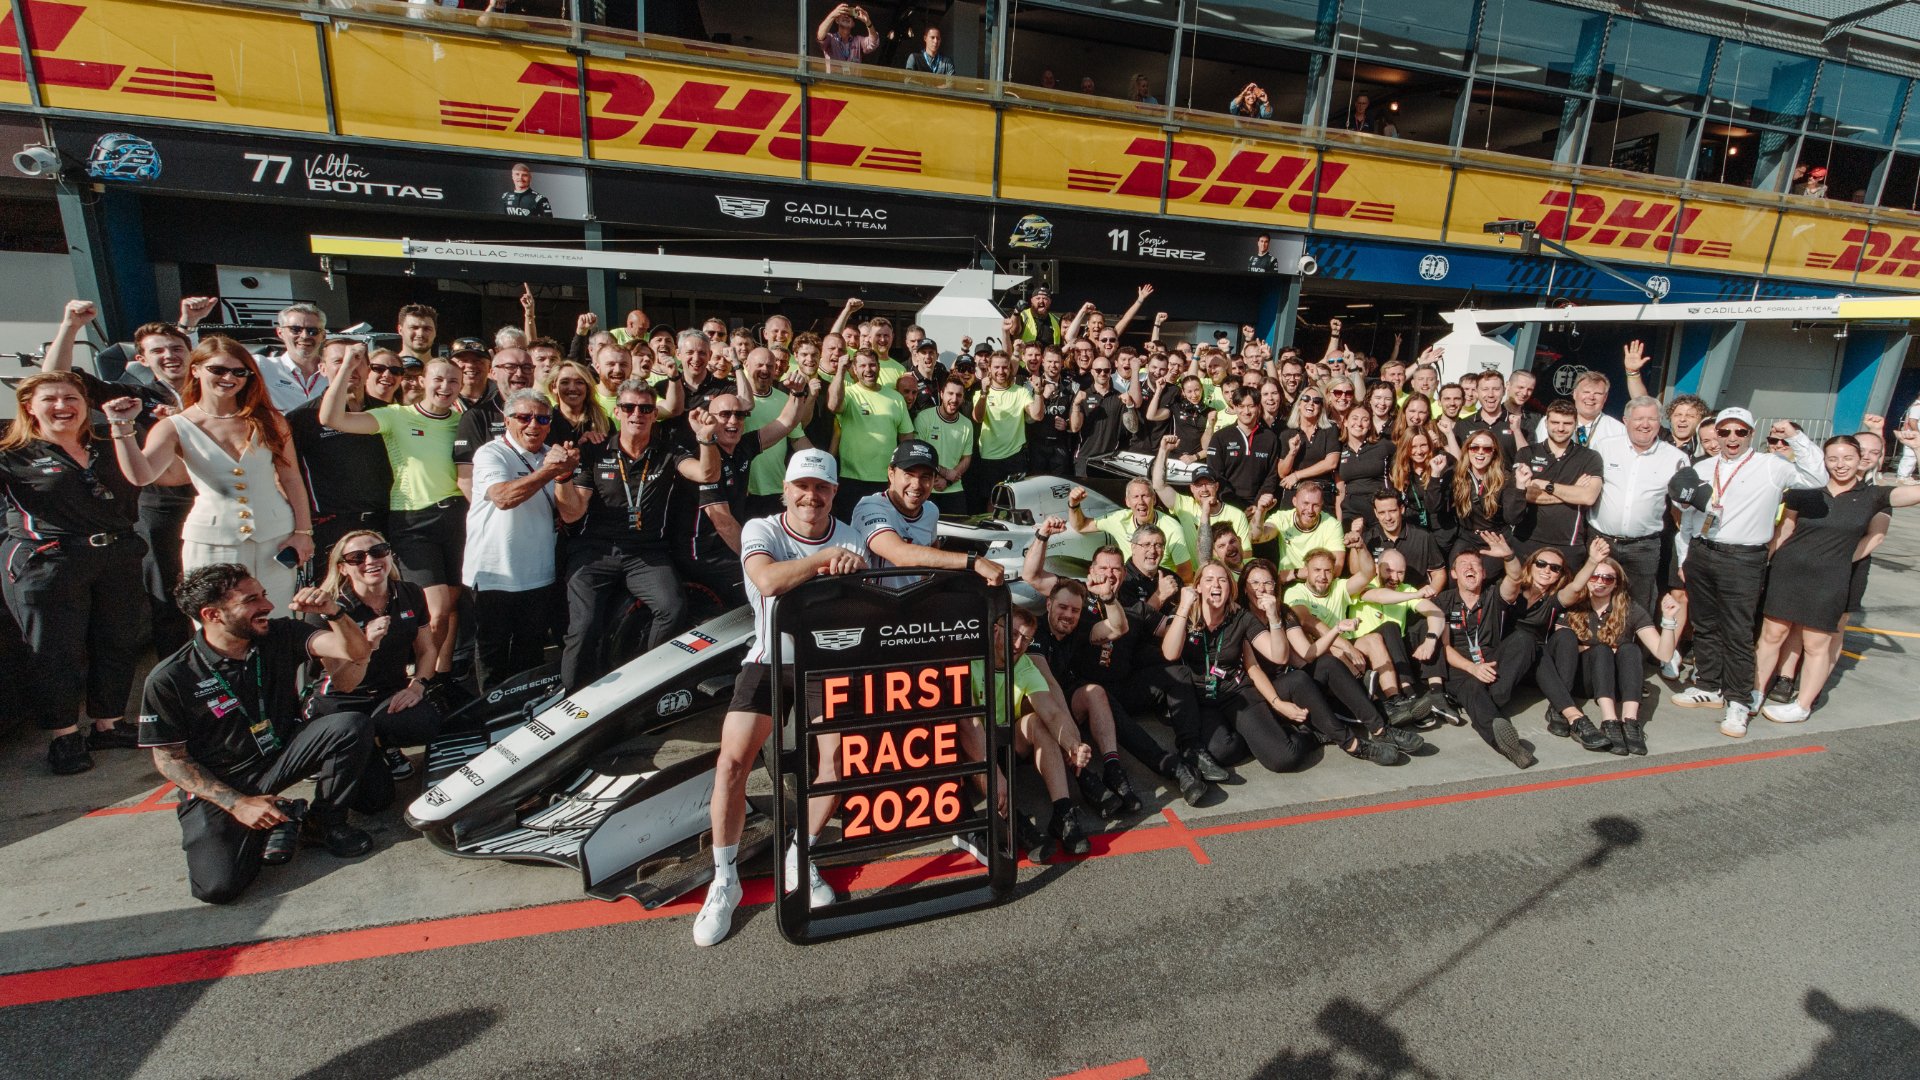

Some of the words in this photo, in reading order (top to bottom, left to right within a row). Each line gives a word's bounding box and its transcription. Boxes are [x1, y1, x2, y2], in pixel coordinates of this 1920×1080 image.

[515, 61, 866, 167] DHL
[244, 153, 293, 184] 77
[304, 153, 370, 181] Valtteri
[1116, 137, 1356, 217] DHL
[308, 178, 444, 200] BOTTAS
[784, 201, 888, 220] CADILLAC
[785, 216, 842, 227] FORMULA
[852, 221, 887, 231] TEAM
[1535, 189, 1704, 255] DHL
[1108, 228, 1129, 252] 11
[1138, 229, 1168, 250] Sergio
[434, 247, 508, 258] CADILLAC
[1138, 246, 1206, 261] PEREZ
[1830, 228, 1920, 278] DH
[1704, 306, 1762, 314] CADILLAC
[879, 619, 980, 637] CADILLAC
[880, 635, 936, 647] FORMULA
[948, 632, 980, 641] TEAM
[504, 684, 529, 696] CORE
[825, 665, 969, 719] FIRST
[842, 723, 957, 777] RACE
[459, 766, 485, 787] ENNECO
[844, 782, 961, 838] 2026
